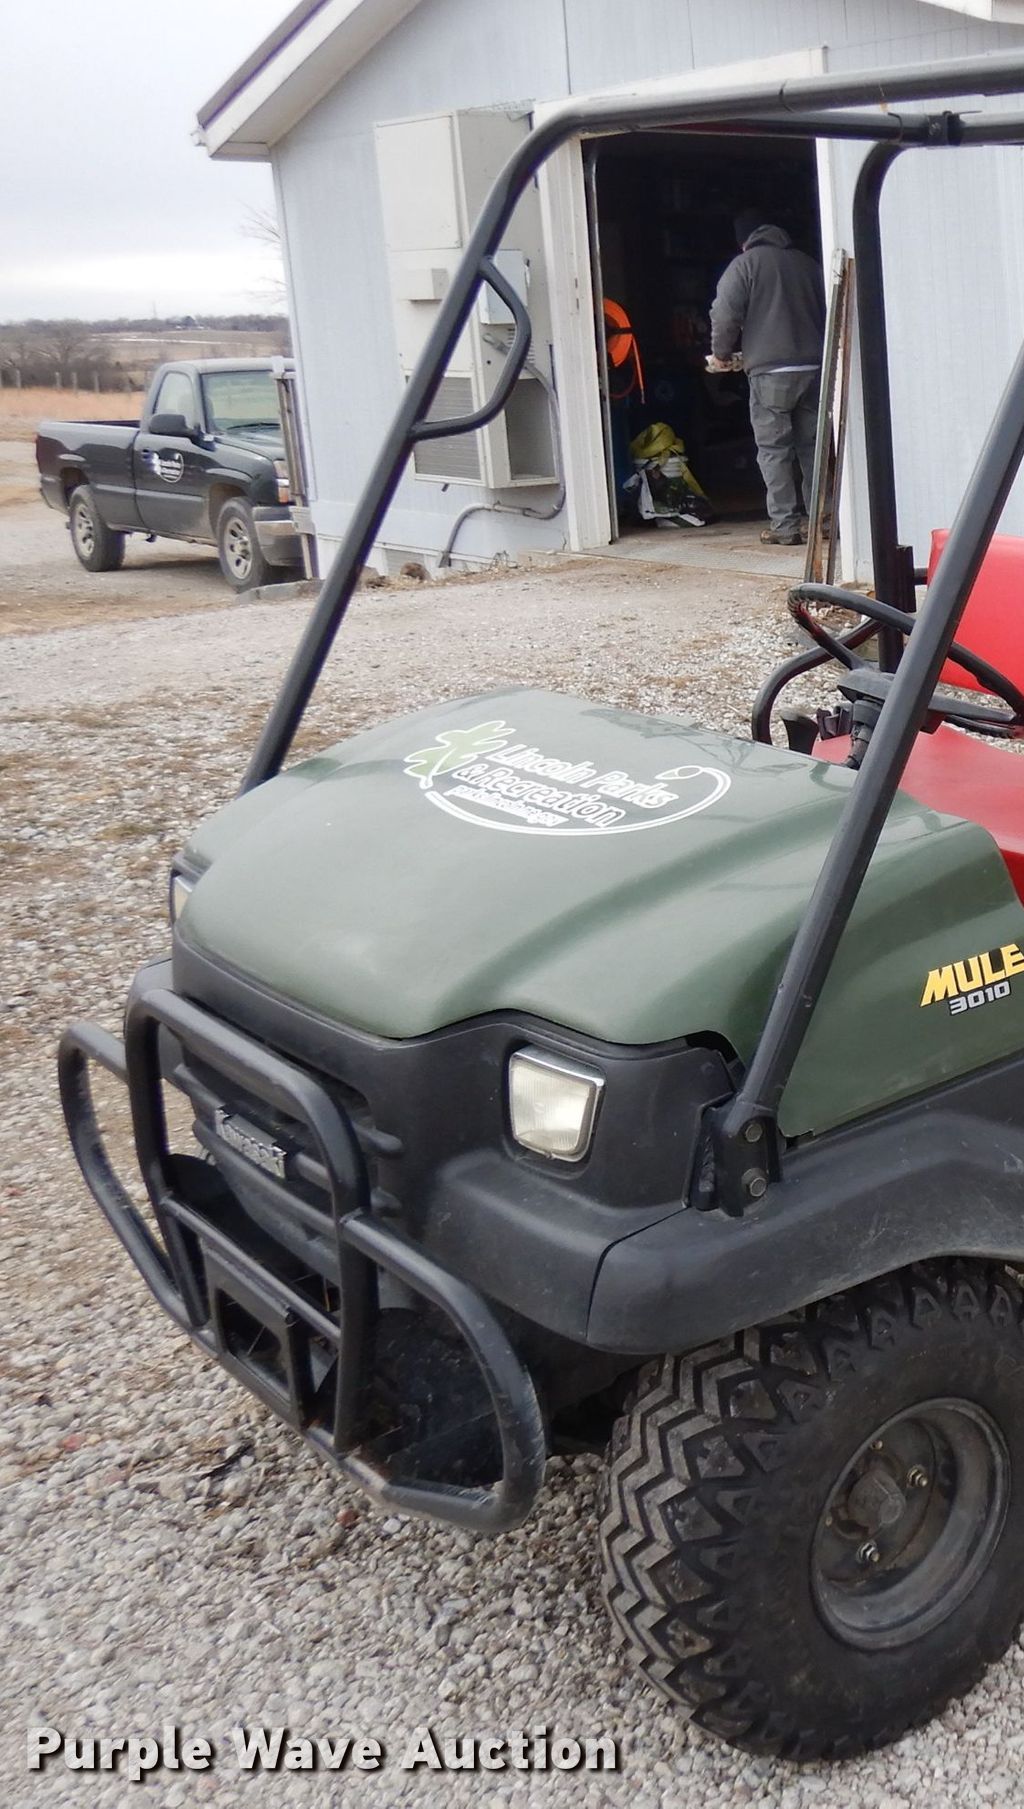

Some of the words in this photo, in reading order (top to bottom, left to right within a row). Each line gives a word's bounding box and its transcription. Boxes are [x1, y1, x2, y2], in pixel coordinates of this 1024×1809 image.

[477, 767, 625, 828] Recreation
[486, 744, 597, 784] Lincoln
[579, 771, 680, 809] Parks
[949, 980, 1012, 1015] 3010
